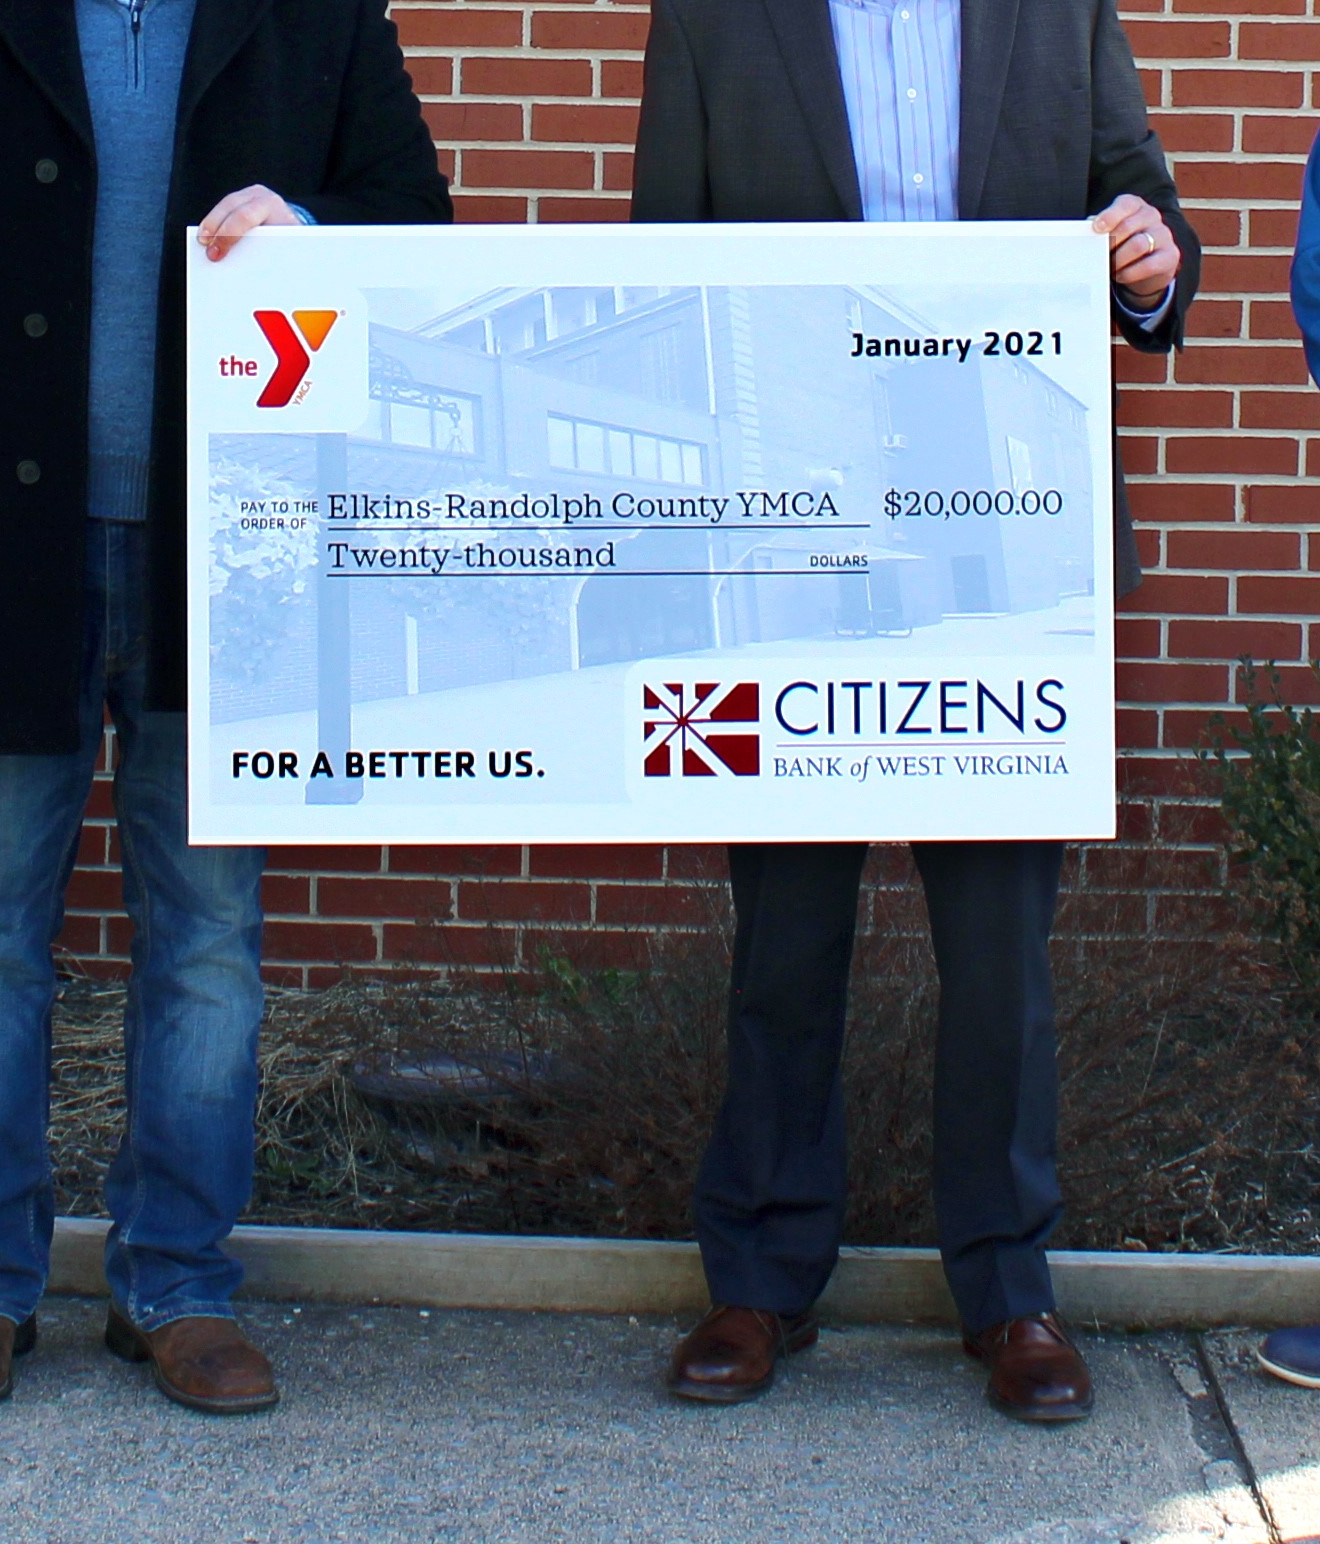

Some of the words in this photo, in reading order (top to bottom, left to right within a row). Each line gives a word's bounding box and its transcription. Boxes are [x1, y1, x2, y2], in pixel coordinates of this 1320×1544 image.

[850, 332, 972, 363] January
[983, 331, 1064, 356] 2021
[219, 355, 258, 377] the
[292, 380, 313, 406] YMCA
[240, 501, 267, 513] PAY
[271, 501, 289, 513] TO
[293, 501, 319, 513] THE
[327, 493, 603, 524] Elkins-Randolph
[611, 492, 730, 522] County
[736, 492, 840, 517] YMCA
[883, 488, 1063, 521] $20,000.00
[240, 517, 285, 530] ORDER
[290, 517, 307, 530] OF
[327, 542, 616, 574] Twenty-thousand
[809, 554, 869, 568] DOLLARS
[774, 678, 1067, 736] CITIZENS
[232, 751, 299, 779] FOR
[310, 751, 334, 779] A
[345, 751, 476, 778] BETTER
[489, 750, 546, 778] US.
[774, 757, 844, 778] BANK
[849, 755, 877, 784] of
[877, 756, 947, 777] WEST
[956, 754, 1070, 776] VIRGINIA
